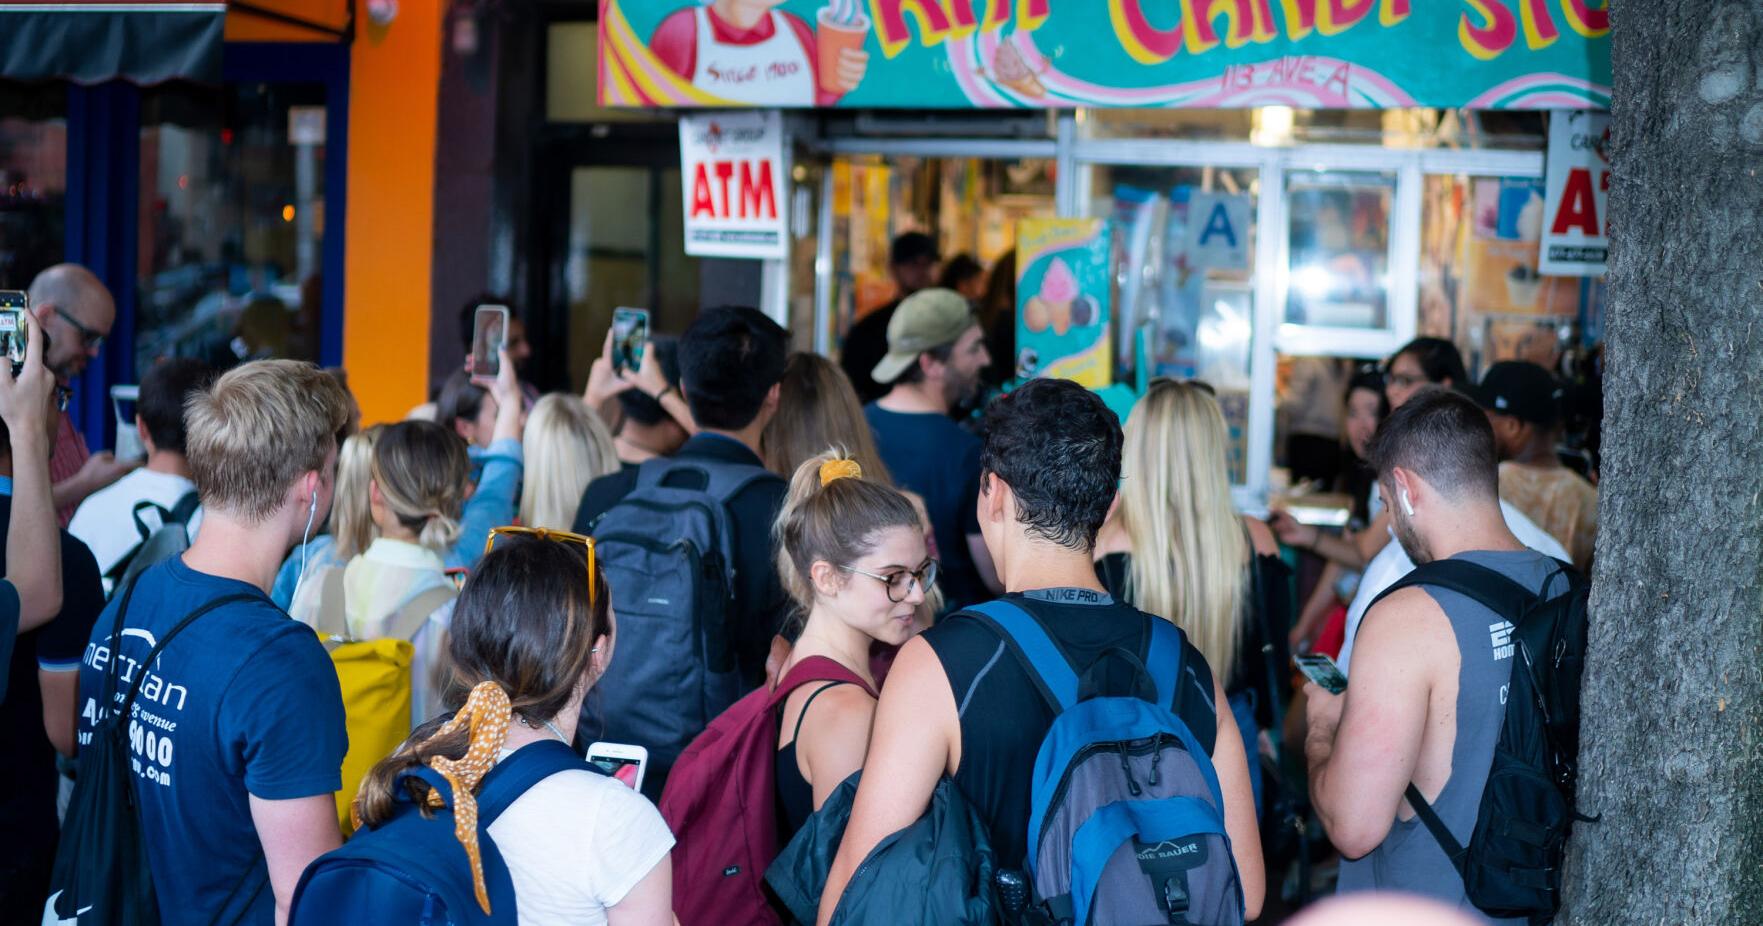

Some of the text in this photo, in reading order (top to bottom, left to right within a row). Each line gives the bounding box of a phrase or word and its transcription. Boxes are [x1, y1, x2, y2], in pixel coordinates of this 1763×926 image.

[689, 158, 779, 220] ATM
[1198, 201, 1237, 248] A
[1045, 588, 1099, 603] NIKE PRO
[1158, 842, 1198, 859] BAUER
